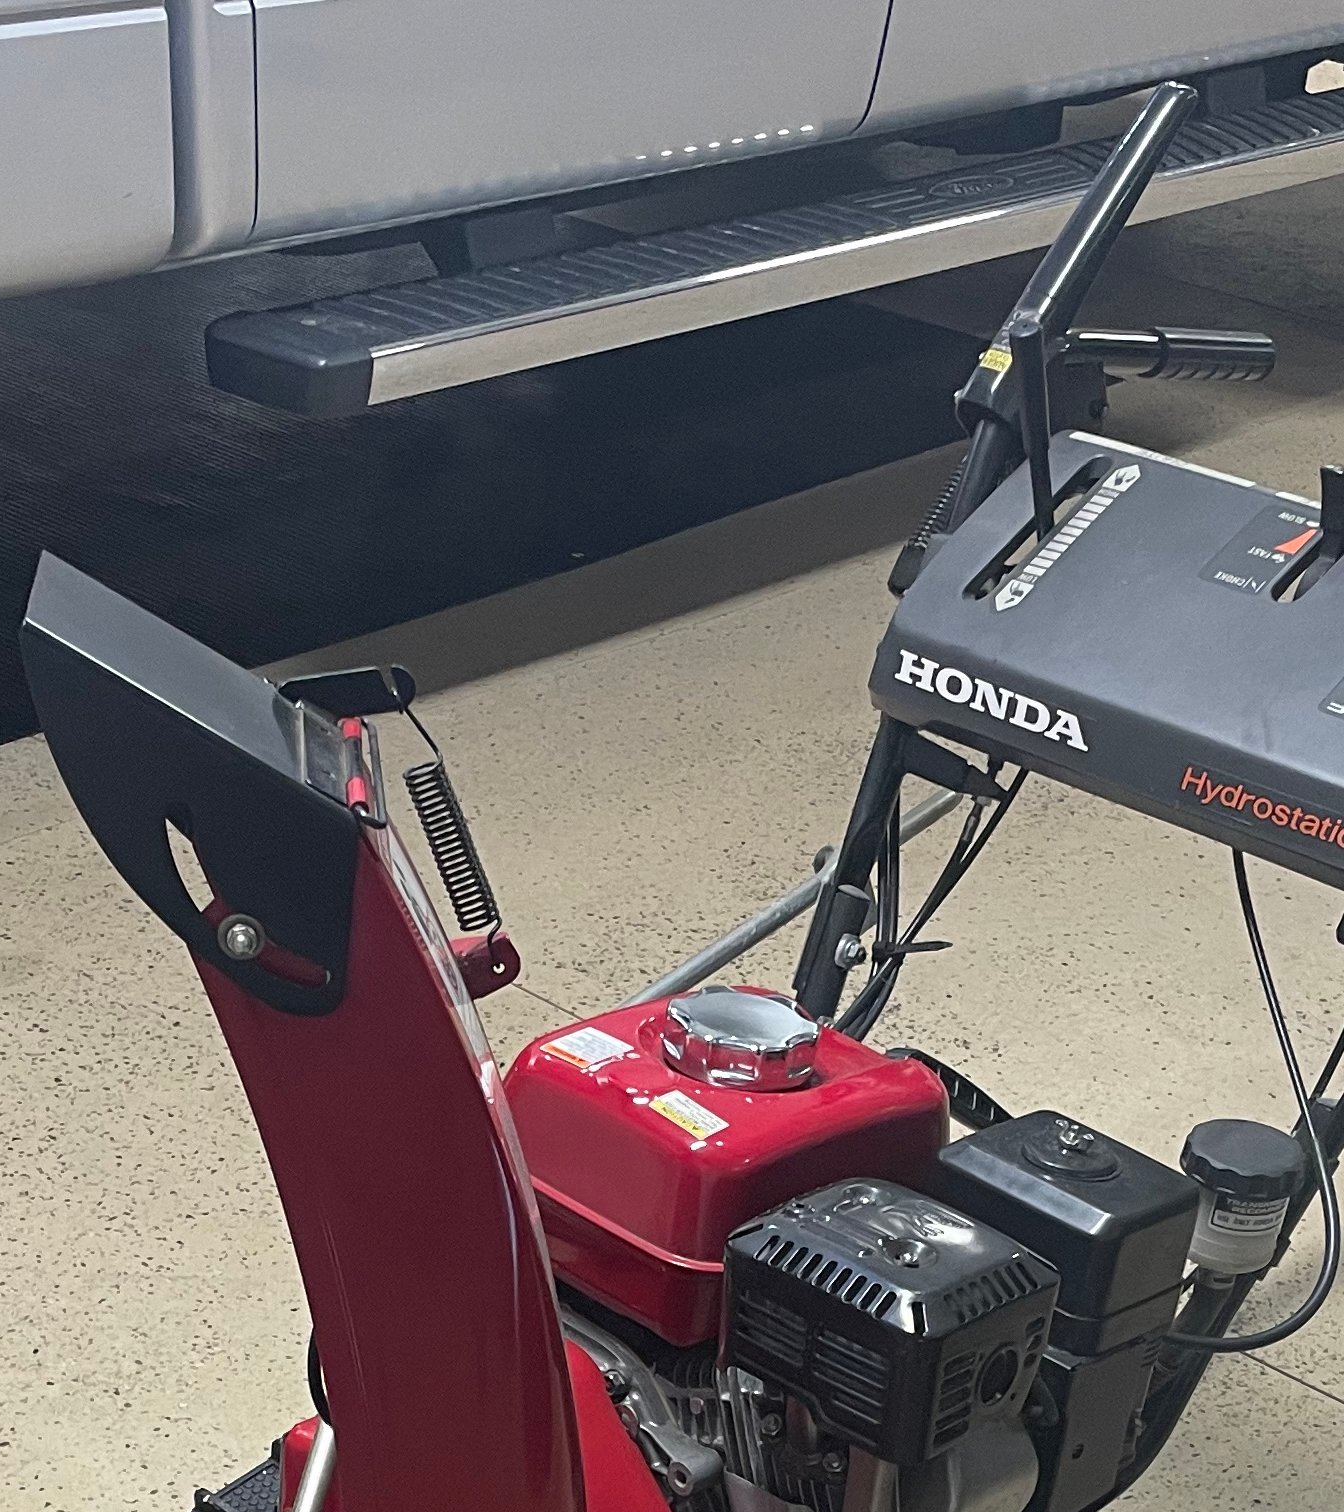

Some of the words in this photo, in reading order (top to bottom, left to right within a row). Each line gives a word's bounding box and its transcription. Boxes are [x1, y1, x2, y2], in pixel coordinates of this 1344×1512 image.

[1247, 546, 1272, 560] FAST
[1213, 571, 1246, 588] CHOKE
[894, 649, 1089, 752] HONDA
